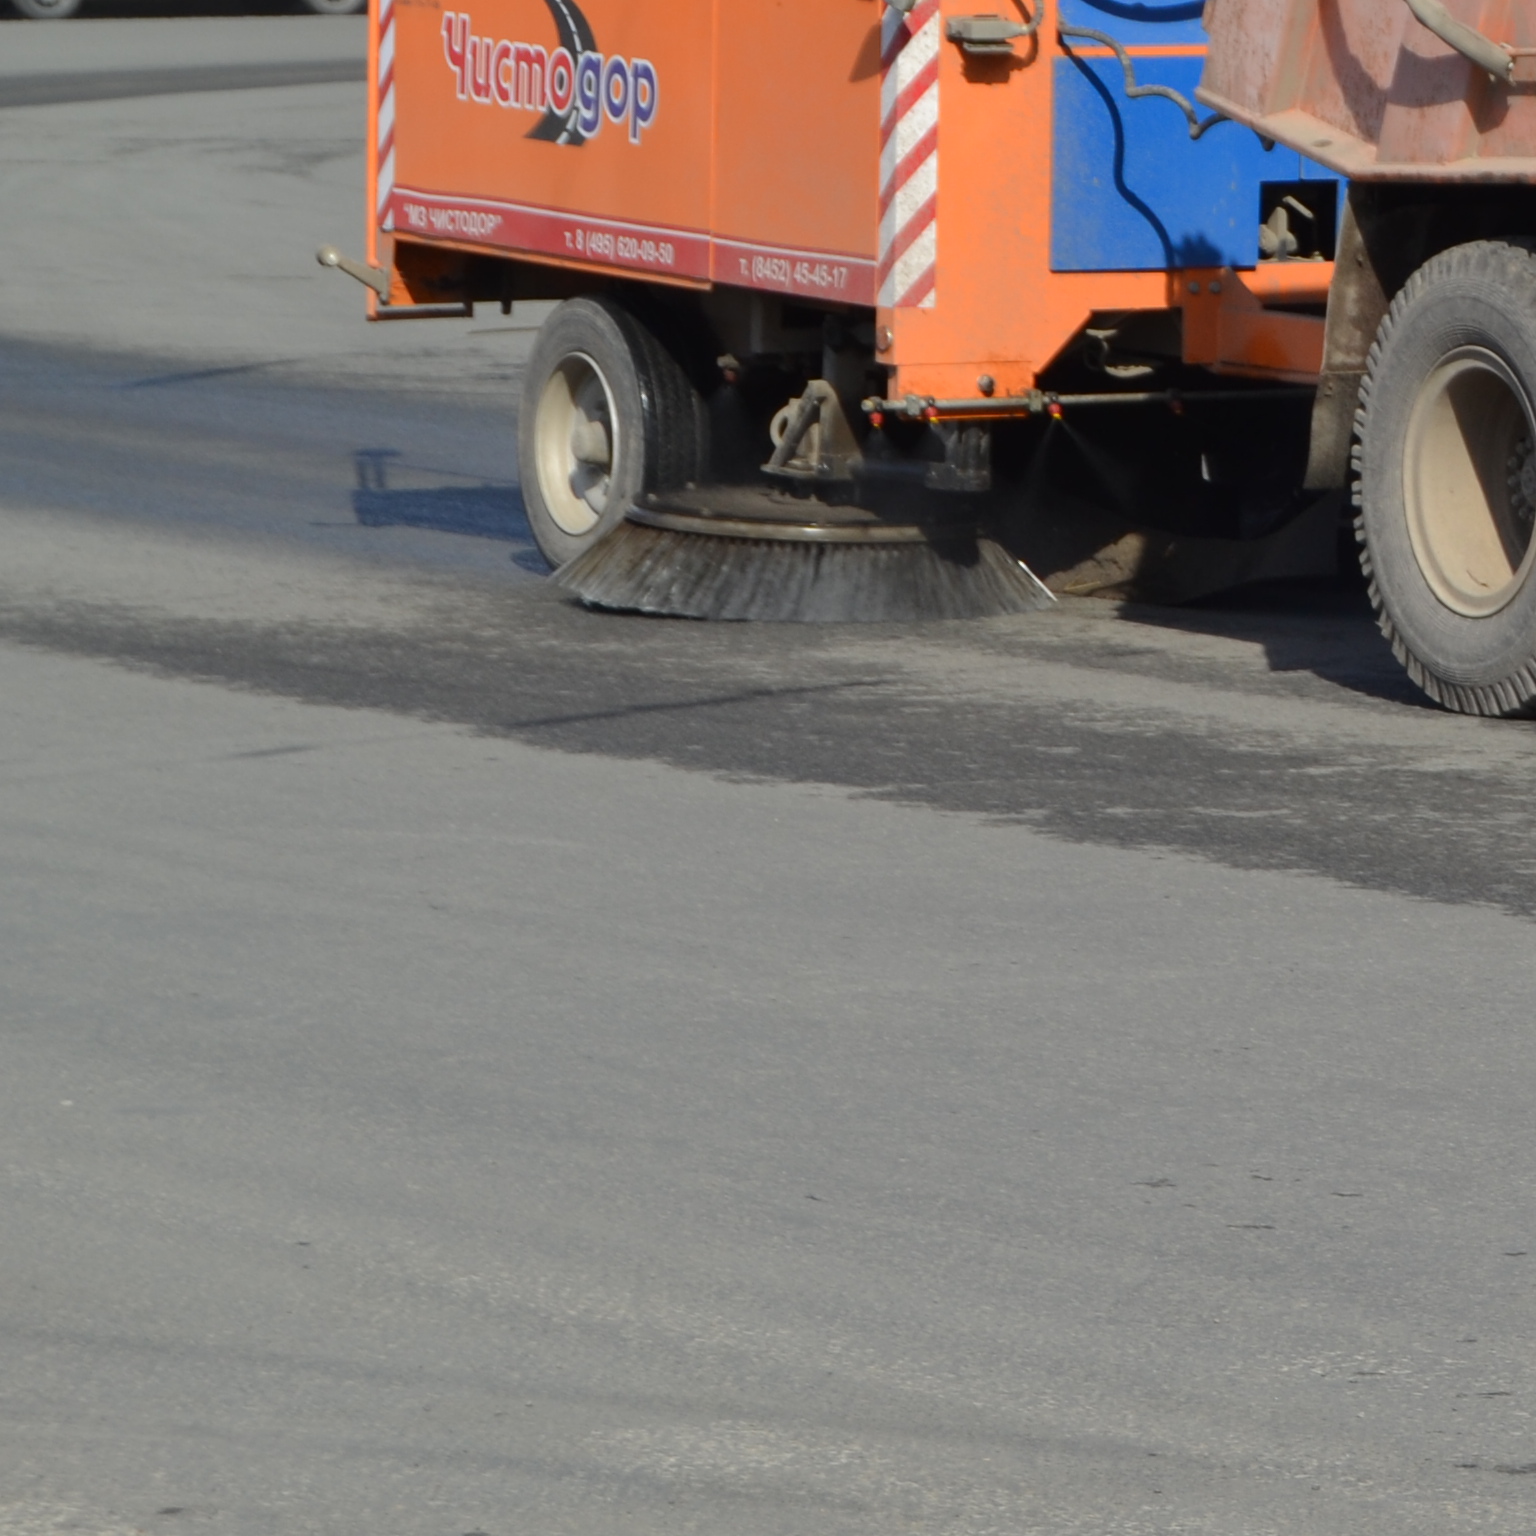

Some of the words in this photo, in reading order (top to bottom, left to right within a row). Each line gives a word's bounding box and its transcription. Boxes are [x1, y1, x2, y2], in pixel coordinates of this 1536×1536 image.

[441, 11, 659, 145] Чистодор
[576, 229, 585, 250] 8
[585, 230, 616, 260] (495)
[617, 237, 675, 265] 620-09-50
[752, 255, 792, 286] (8452)
[793, 261, 848, 288] 45-45-17
